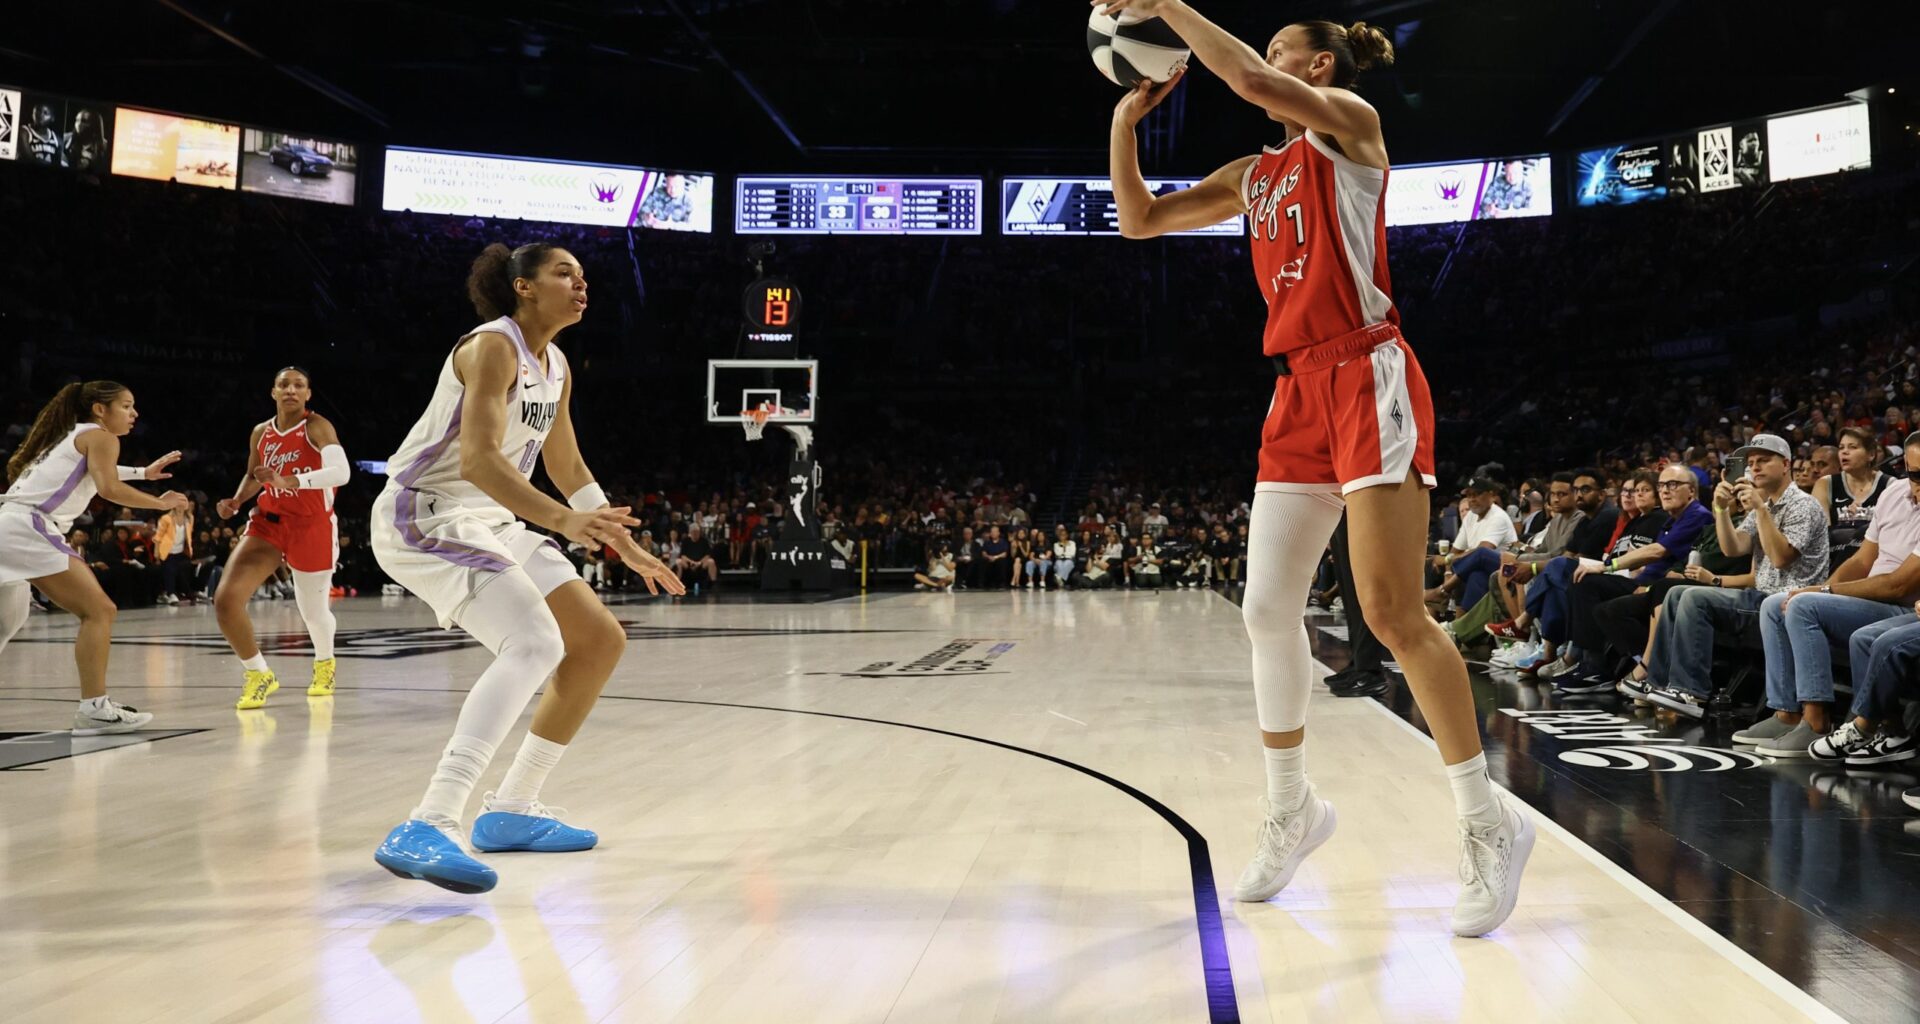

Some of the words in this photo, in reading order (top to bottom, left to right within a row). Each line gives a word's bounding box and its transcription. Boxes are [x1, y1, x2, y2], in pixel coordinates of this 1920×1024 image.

[1622, 164, 1654, 181] ONE
[852, 184, 872, 194] 1:41
[1705, 180, 1730, 189] ACES
[872, 206, 890, 218] 30
[1285, 202, 1305, 245] 7
[765, 301, 788, 325] 13
[760, 333, 793, 342] TISSOT
[521, 401, 559, 433] VALKY
[264, 442, 303, 474] Vegas
[1498, 707, 1685, 742] AT&T
